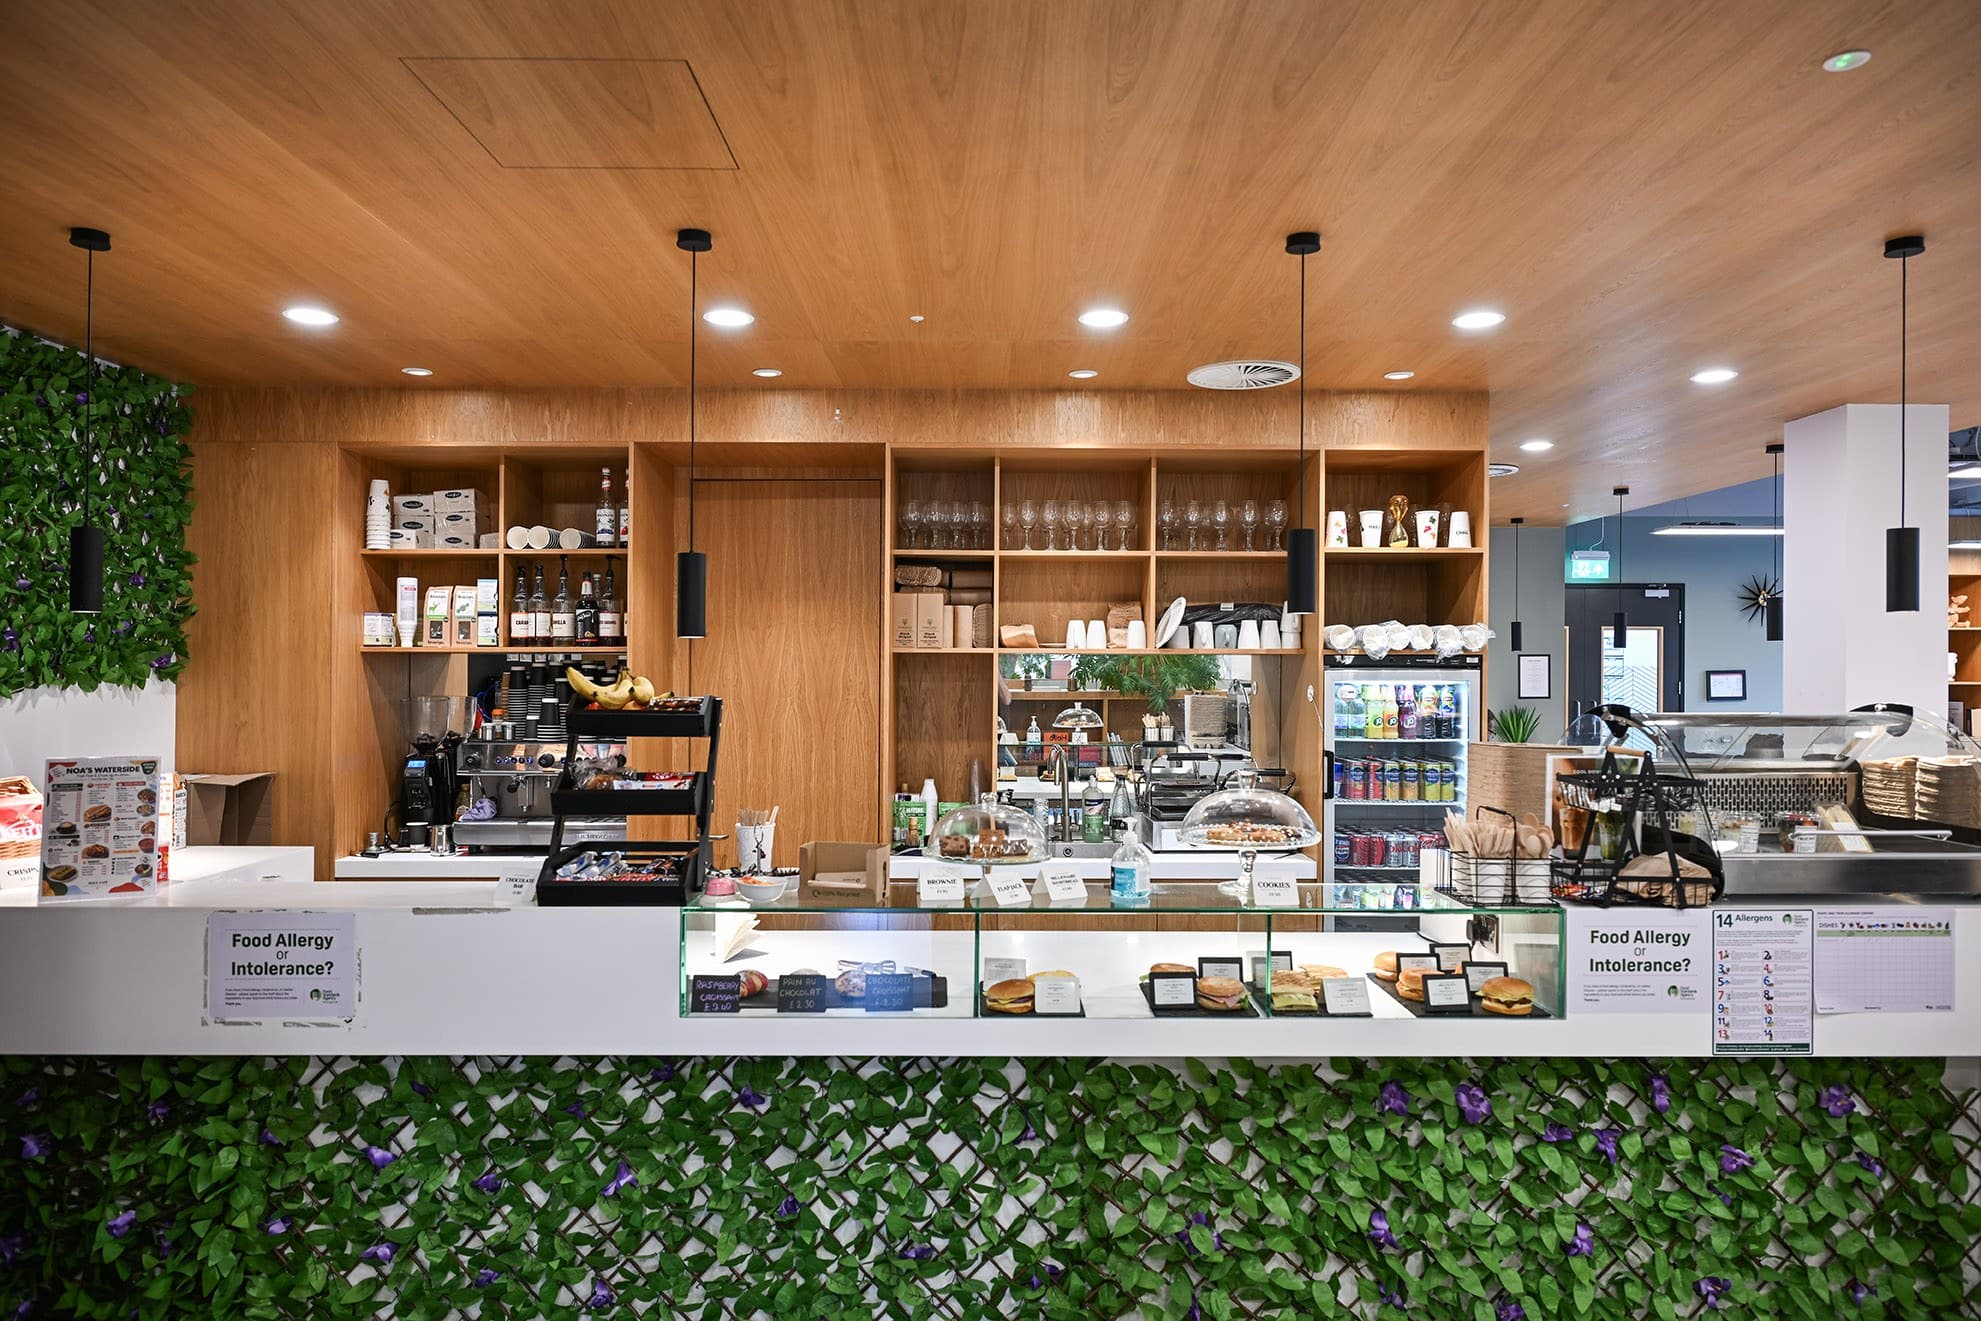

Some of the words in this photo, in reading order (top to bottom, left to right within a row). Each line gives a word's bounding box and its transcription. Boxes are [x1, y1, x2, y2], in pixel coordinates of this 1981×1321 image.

[7, 865, 39, 877] CRISPS
[997, 882, 1023, 892] FLAPJACK
[1257, 881, 1291, 889] COOKIES
[1716, 914, 1734, 928] 14
[1735, 914, 1773, 923] Allergens
[232, 933, 272, 948] Food
[275, 933, 334, 950] Allergy
[1590, 930, 1629, 944] Food
[1633, 930, 1691, 947] Allergy
[276, 950, 289, 960] or
[1634, 947, 1647, 957] or
[231, 961, 334, 976] Intolerance?
[1589, 958, 1691, 972] Intolerance?
[695, 980, 739, 991] RASPBERRY
[783, 977, 803, 986] PAIN
[805, 977, 817, 986] AU
[780, 987, 823, 998] CHOCOLAT
